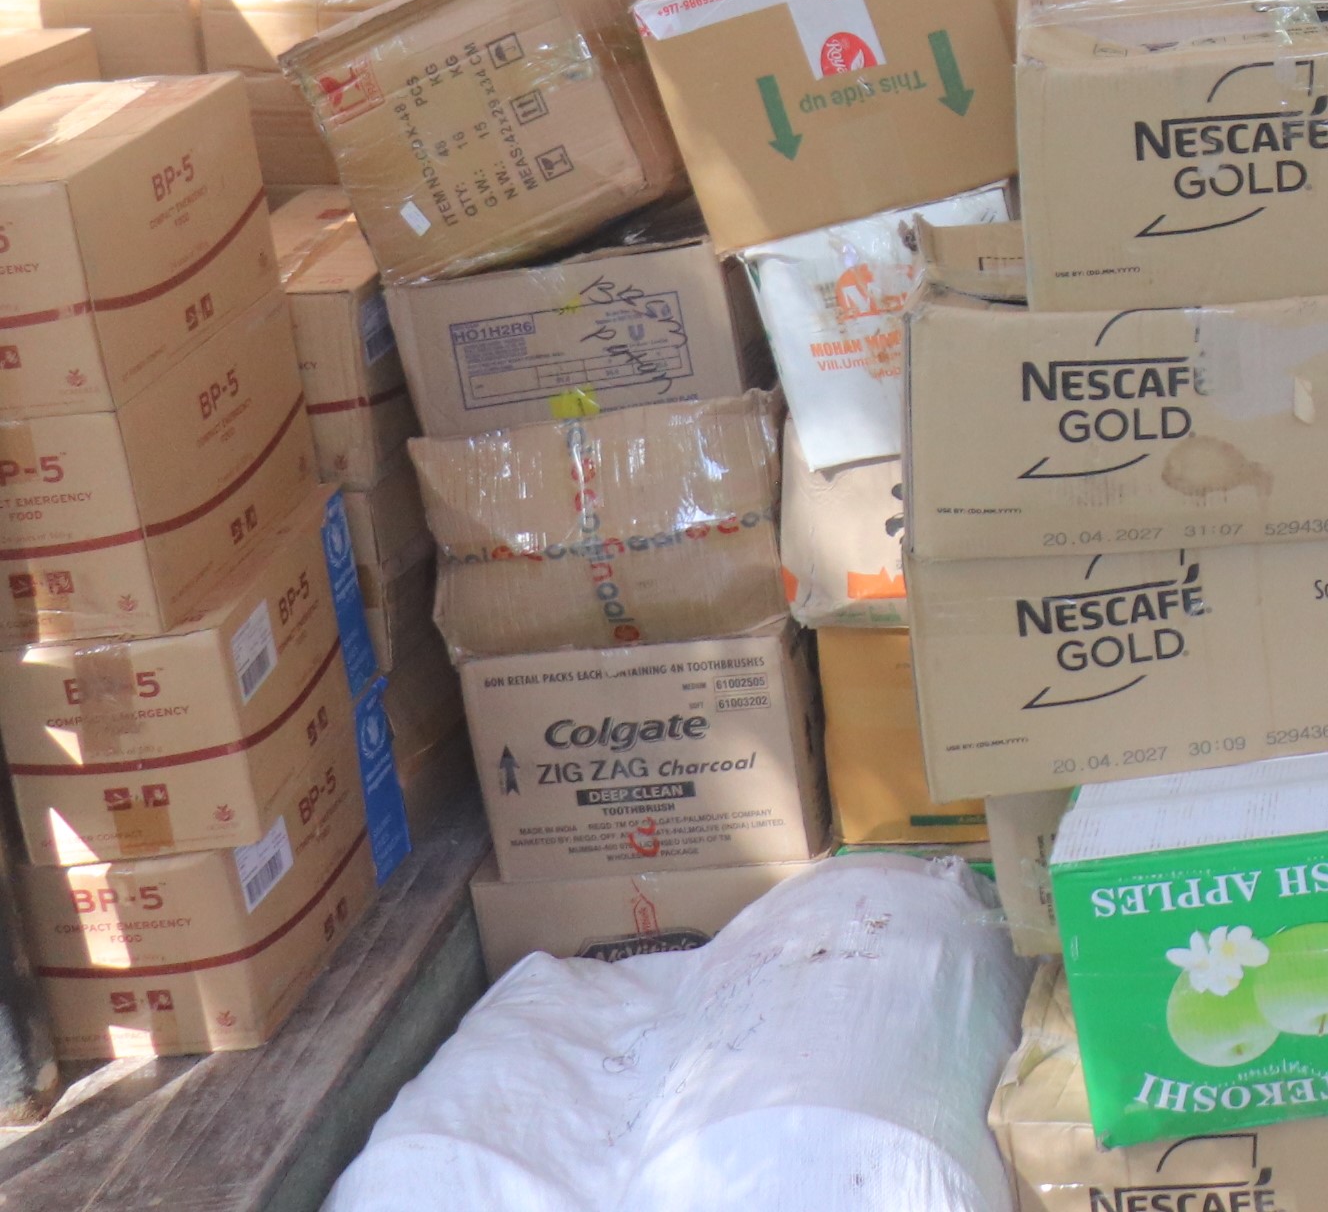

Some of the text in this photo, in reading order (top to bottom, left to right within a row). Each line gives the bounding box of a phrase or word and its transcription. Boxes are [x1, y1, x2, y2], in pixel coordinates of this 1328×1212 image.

[801, 70, 927, 114] This side up
[152, 154, 194, 201] BP-5
[1174, 160, 1307, 199] GOLD
[200, 368, 238, 420] BP-5
[1059, 406, 1191, 442] GOLD
[9, 510, 42, 521] FOOD
[15, 492, 92, 508] EMERGENCY
[1044, 527, 1163, 546] 20.04.2027
[1016, 563, 1204, 636] NESCAFÉ
[1057, 628, 1185, 670] GOLD
[507, 673, 539, 686] RETAIL
[543, 670, 574, 683] PACKS
[577, 668, 601, 680] EACH
[670, 663, 684, 673] 4N
[688, 657, 764, 671] TOOTHBRUSHES
[545, 714, 709, 751] Colgate
[537, 752, 757, 785] ZIG ZAG Charcoal
[589, 785, 683, 803] DEEP CLEAN
[603, 803, 675, 815] TOOTHBRUSH
[71, 886, 163, 913] BP-5
[1090, 870, 1262, 917] APPLES
[55, 918, 191, 934] COMPACT EMERGENCY
[110, 933, 142, 943] FOOD
